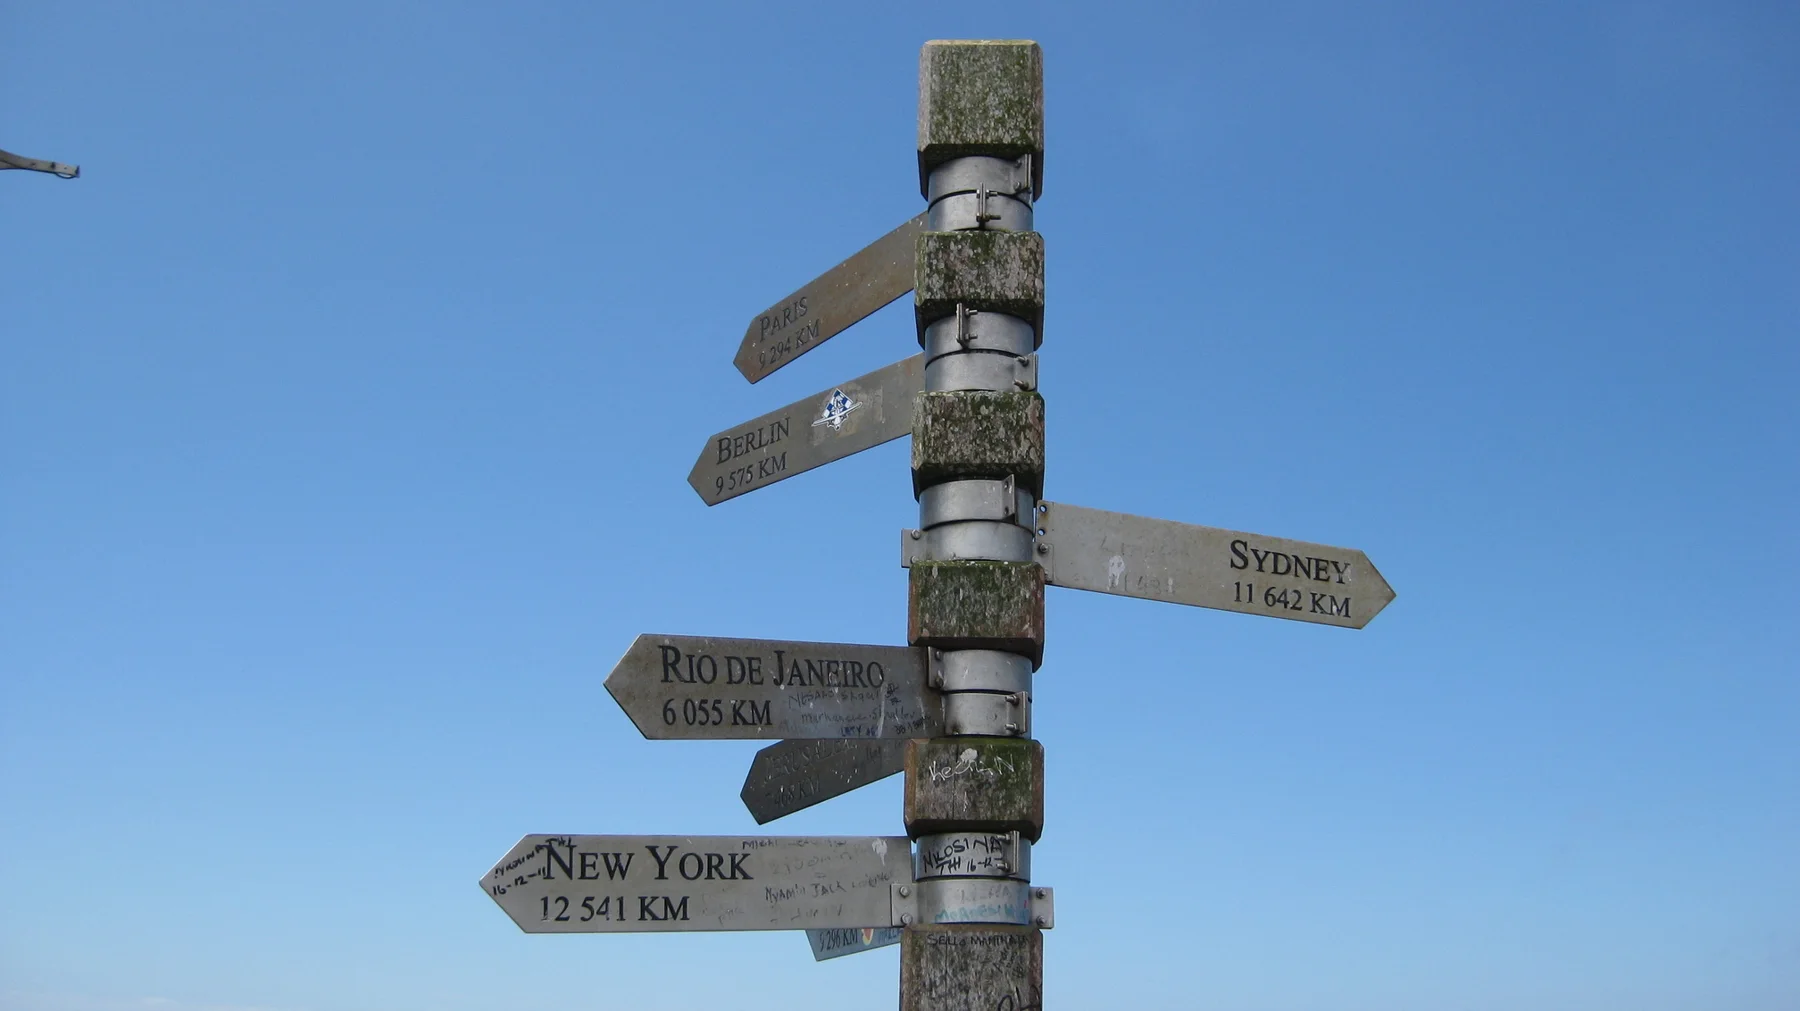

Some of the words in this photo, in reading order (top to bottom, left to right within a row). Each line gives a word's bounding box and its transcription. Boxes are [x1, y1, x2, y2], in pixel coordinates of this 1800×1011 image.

[759, 296, 809, 343] PARIS
[759, 352, 765, 371] 9
[770, 337, 791, 365] 294
[796, 318, 821, 350] KM
[716, 417, 792, 465] BERLIN
[715, 476, 724, 496] 9
[728, 465, 753, 491] 575
[758, 452, 788, 479] KM
[1229, 539, 1352, 585] SYDNEY
[1233, 581, 1254, 605] 11
[1264, 585, 1303, 611] 642
[1310, 592, 1352, 618] KM
[657, 645, 718, 685] RIO
[724, 655, 764, 685] DE
[773, 650, 885, 688] JANEIRO
[662, 698, 677, 726] 6
[683, 698, 723, 726] 055
[731, 700, 773, 726] KM
[543, 843, 635, 881] NEW
[645, 845, 753, 881] YORK
[540, 896, 571, 922] 12
[580, 896, 626, 922] 541
[638, 896, 690, 921] KM
[842, 928, 858, 947] KM
